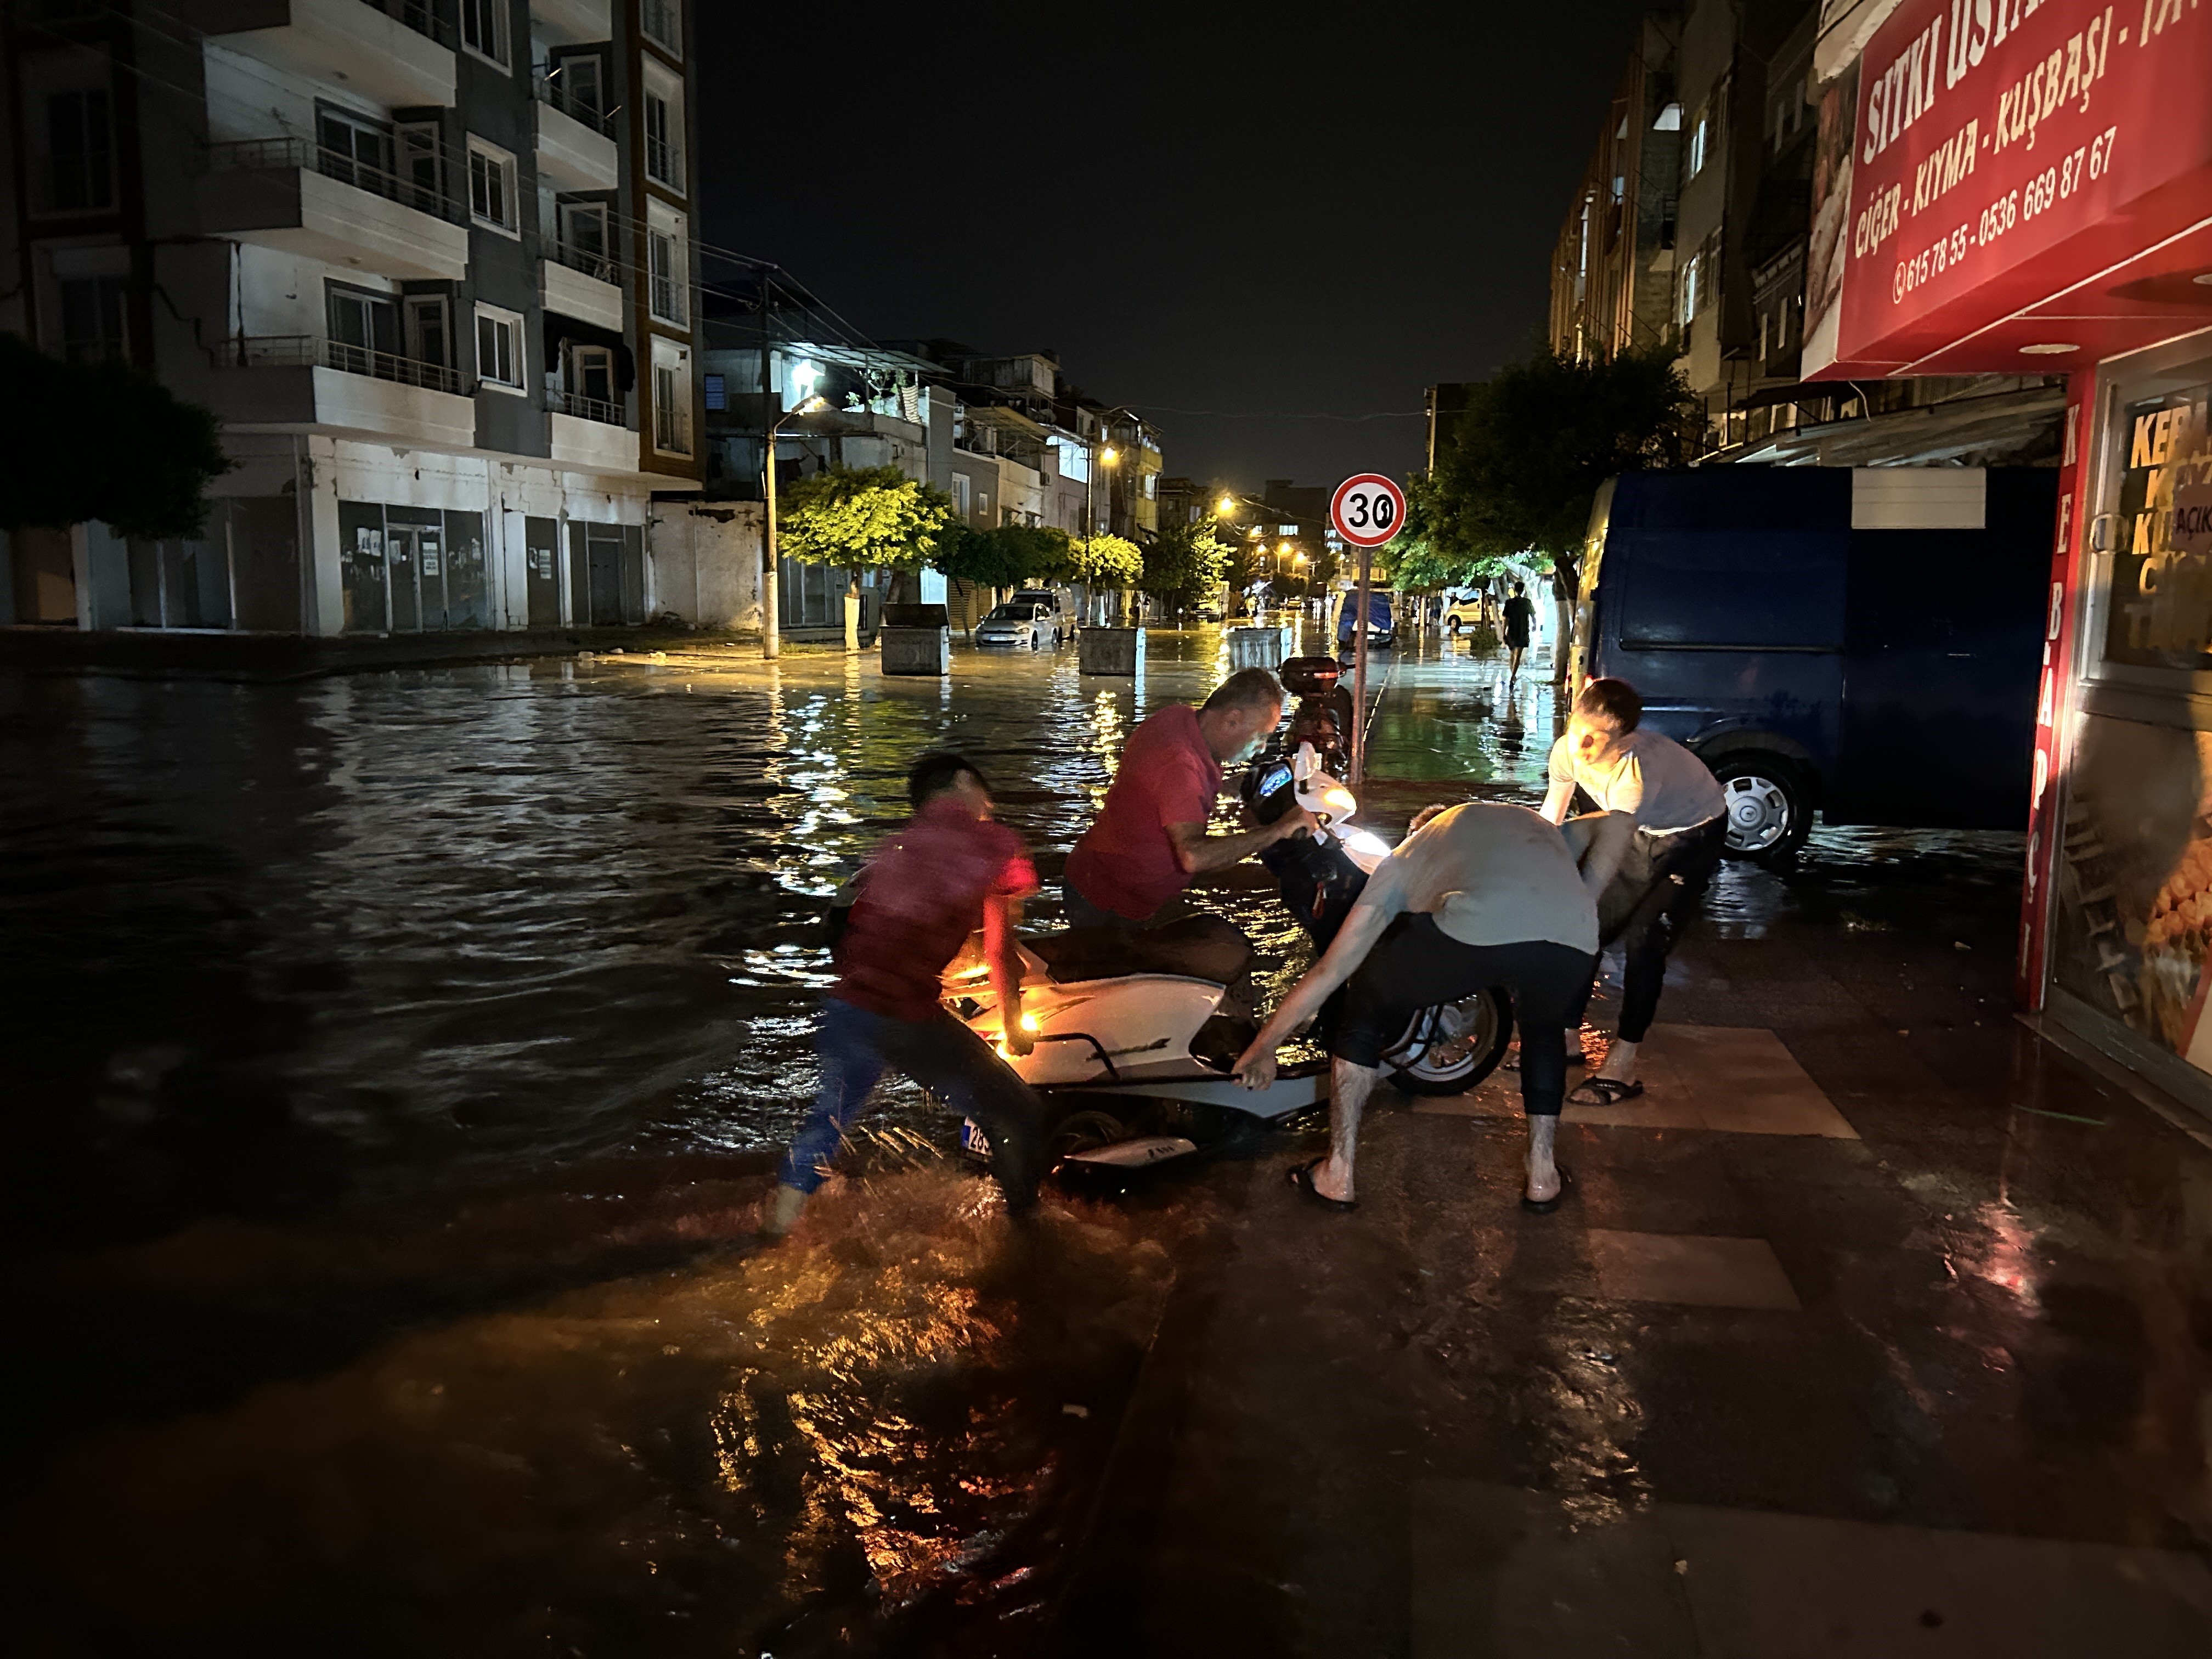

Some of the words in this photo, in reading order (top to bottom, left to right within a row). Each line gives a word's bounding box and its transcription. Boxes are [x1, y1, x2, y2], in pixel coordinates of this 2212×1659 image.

[1855, 183, 1901, 258] CİĞER
[1911, 118, 1978, 217] KIYMA
[1993, 5, 2113, 155] KUŞBAŞI
[1863, 14, 1943, 164] SITKI
[1946, 0, 2045, 90] US
[1906, 249, 1930, 292] 615
[1931, 237, 1947, 277] 78
[1949, 223, 1968, 266] 55
[1979, 189, 2018, 246] 0536
[2023, 167, 2056, 221] 669
[2060, 146, 2086, 199] 87
[2090, 126, 2117, 180] 67
[1348, 493, 1393, 529] 30
